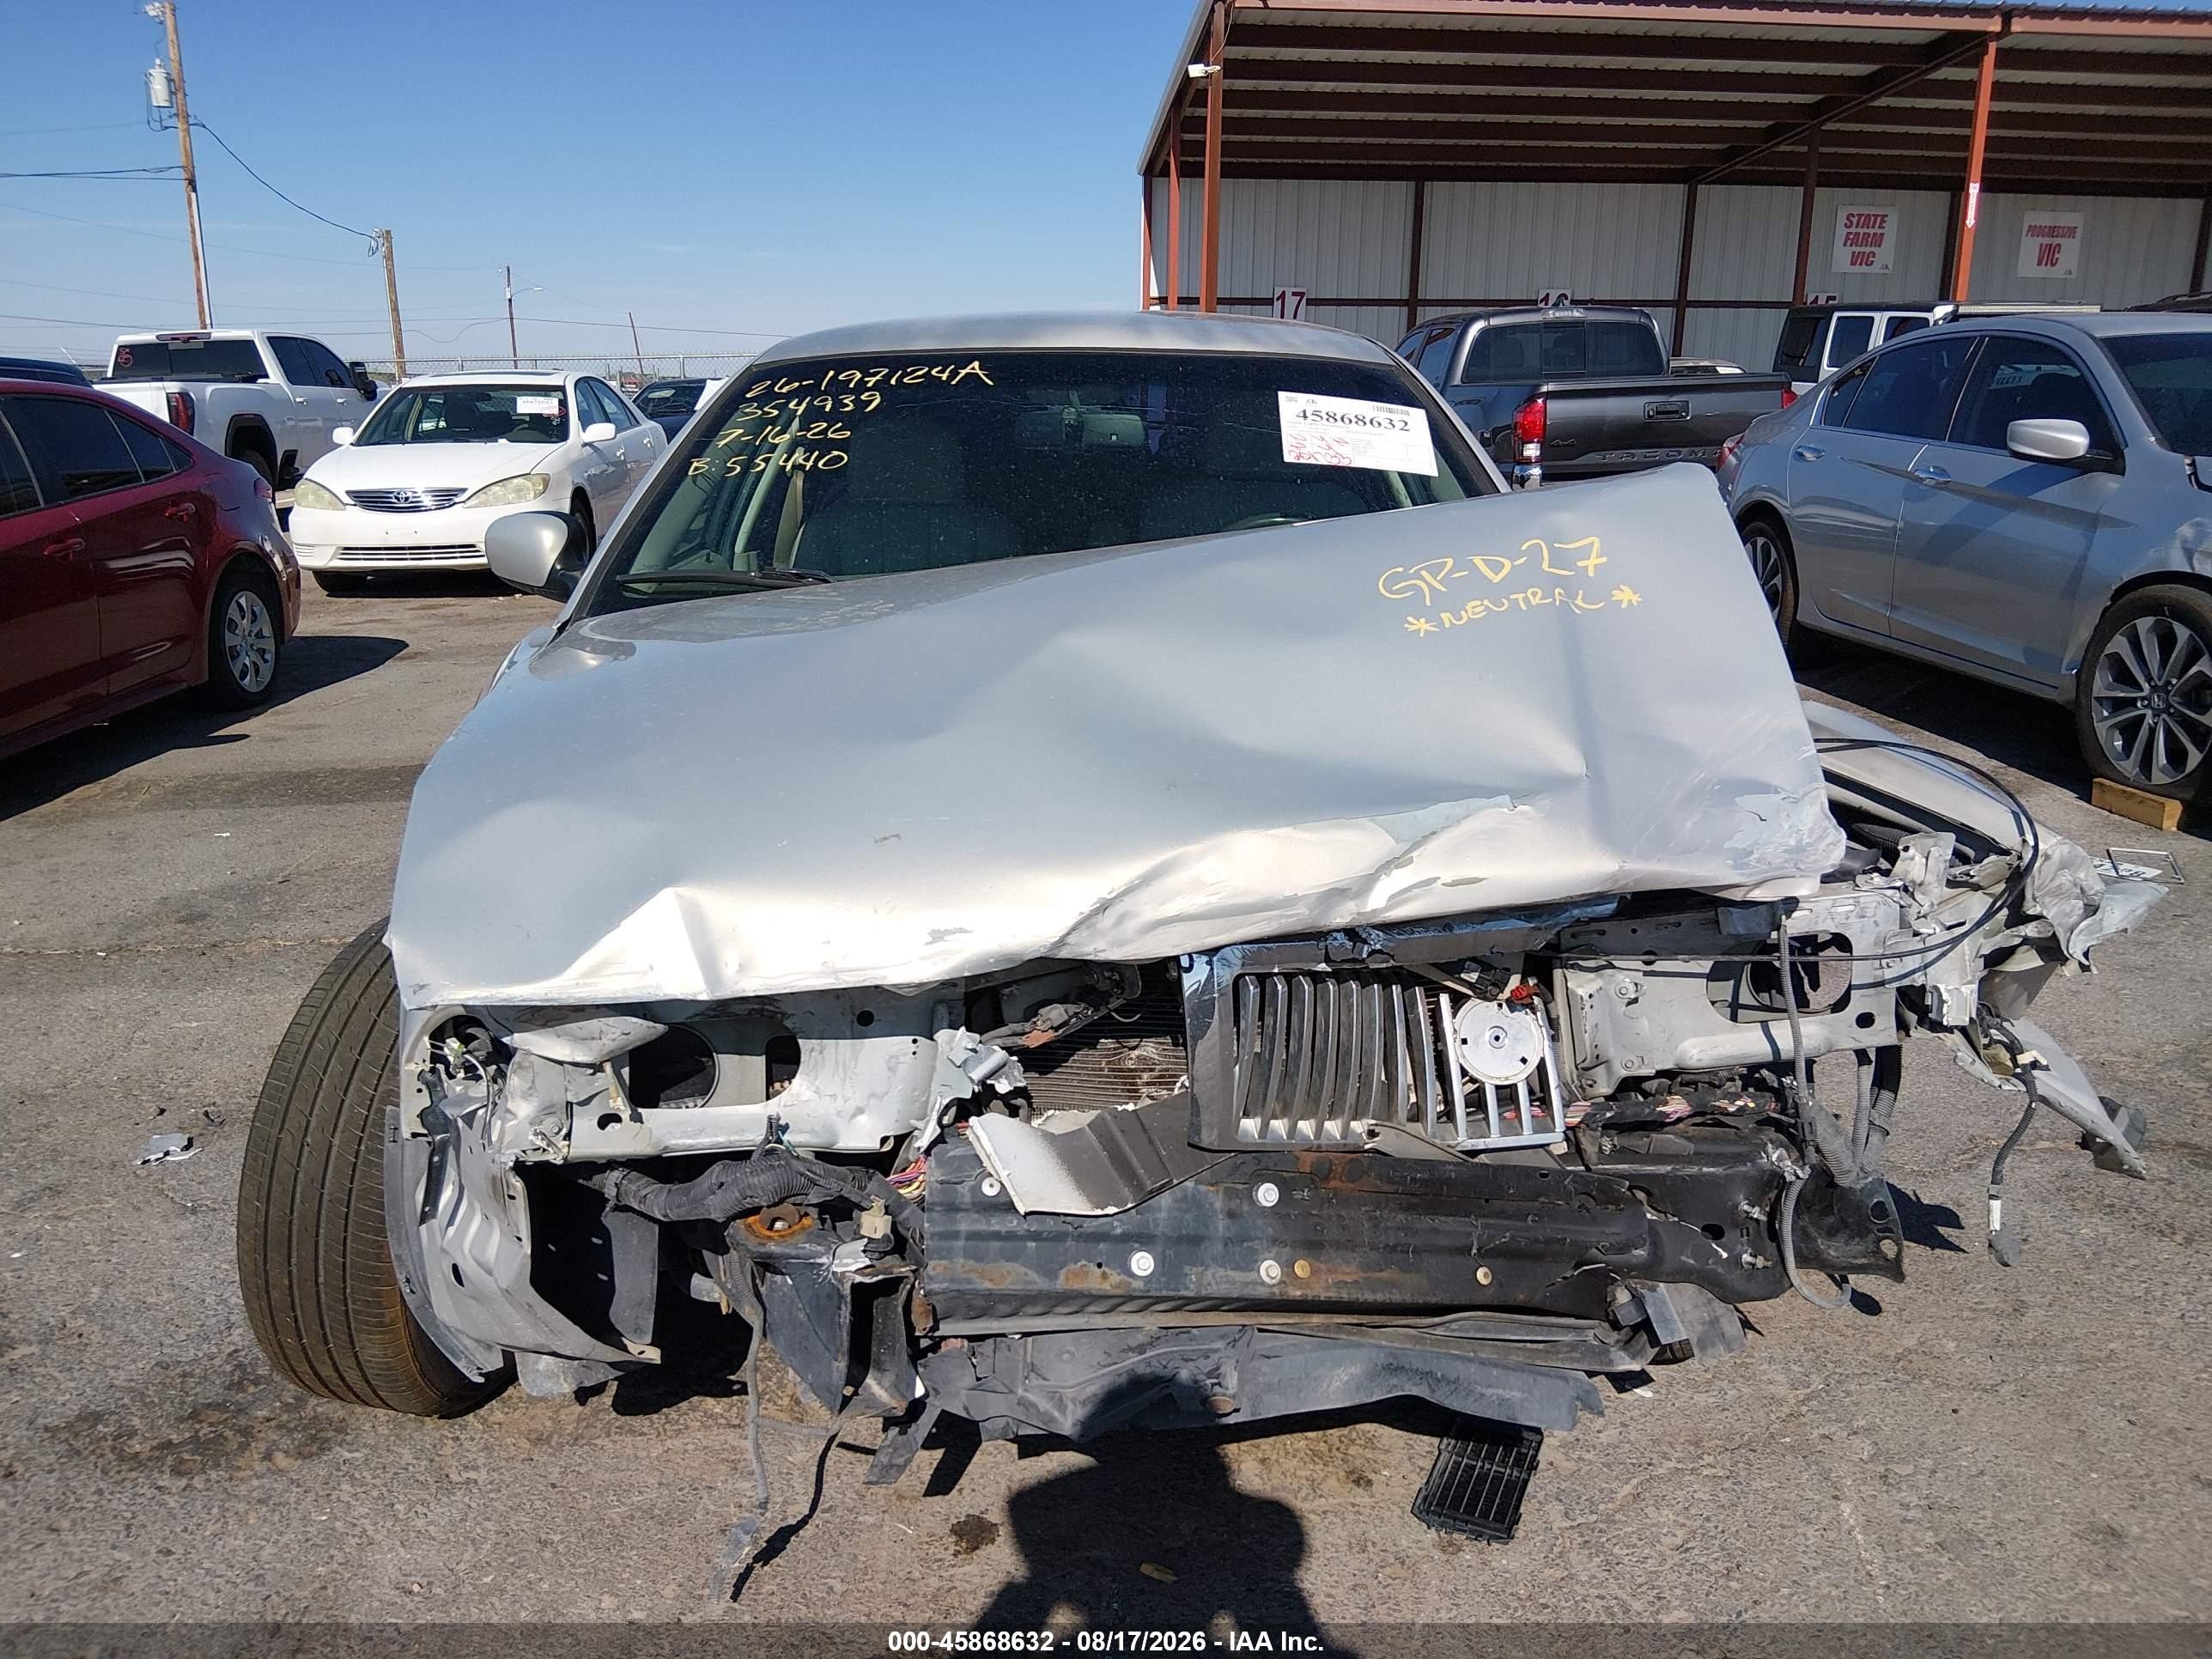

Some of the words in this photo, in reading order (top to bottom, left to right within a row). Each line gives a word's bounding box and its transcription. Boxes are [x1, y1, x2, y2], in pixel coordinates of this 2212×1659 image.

[1844, 212, 1889, 229] STATE
[2025, 224, 2079, 240] PROGRESSIVE
[1842, 231, 1886, 248] FARM
[1849, 251, 1877, 268] VIC
[2036, 242, 2062, 268] VIC
[1275, 289, 1306, 320] 17
[745, 361, 994, 398] 26-197124A
[736, 392, 882, 422] 354939
[1295, 408, 1411, 433] 45868632
[714, 422, 853, 449] 7-16-26
